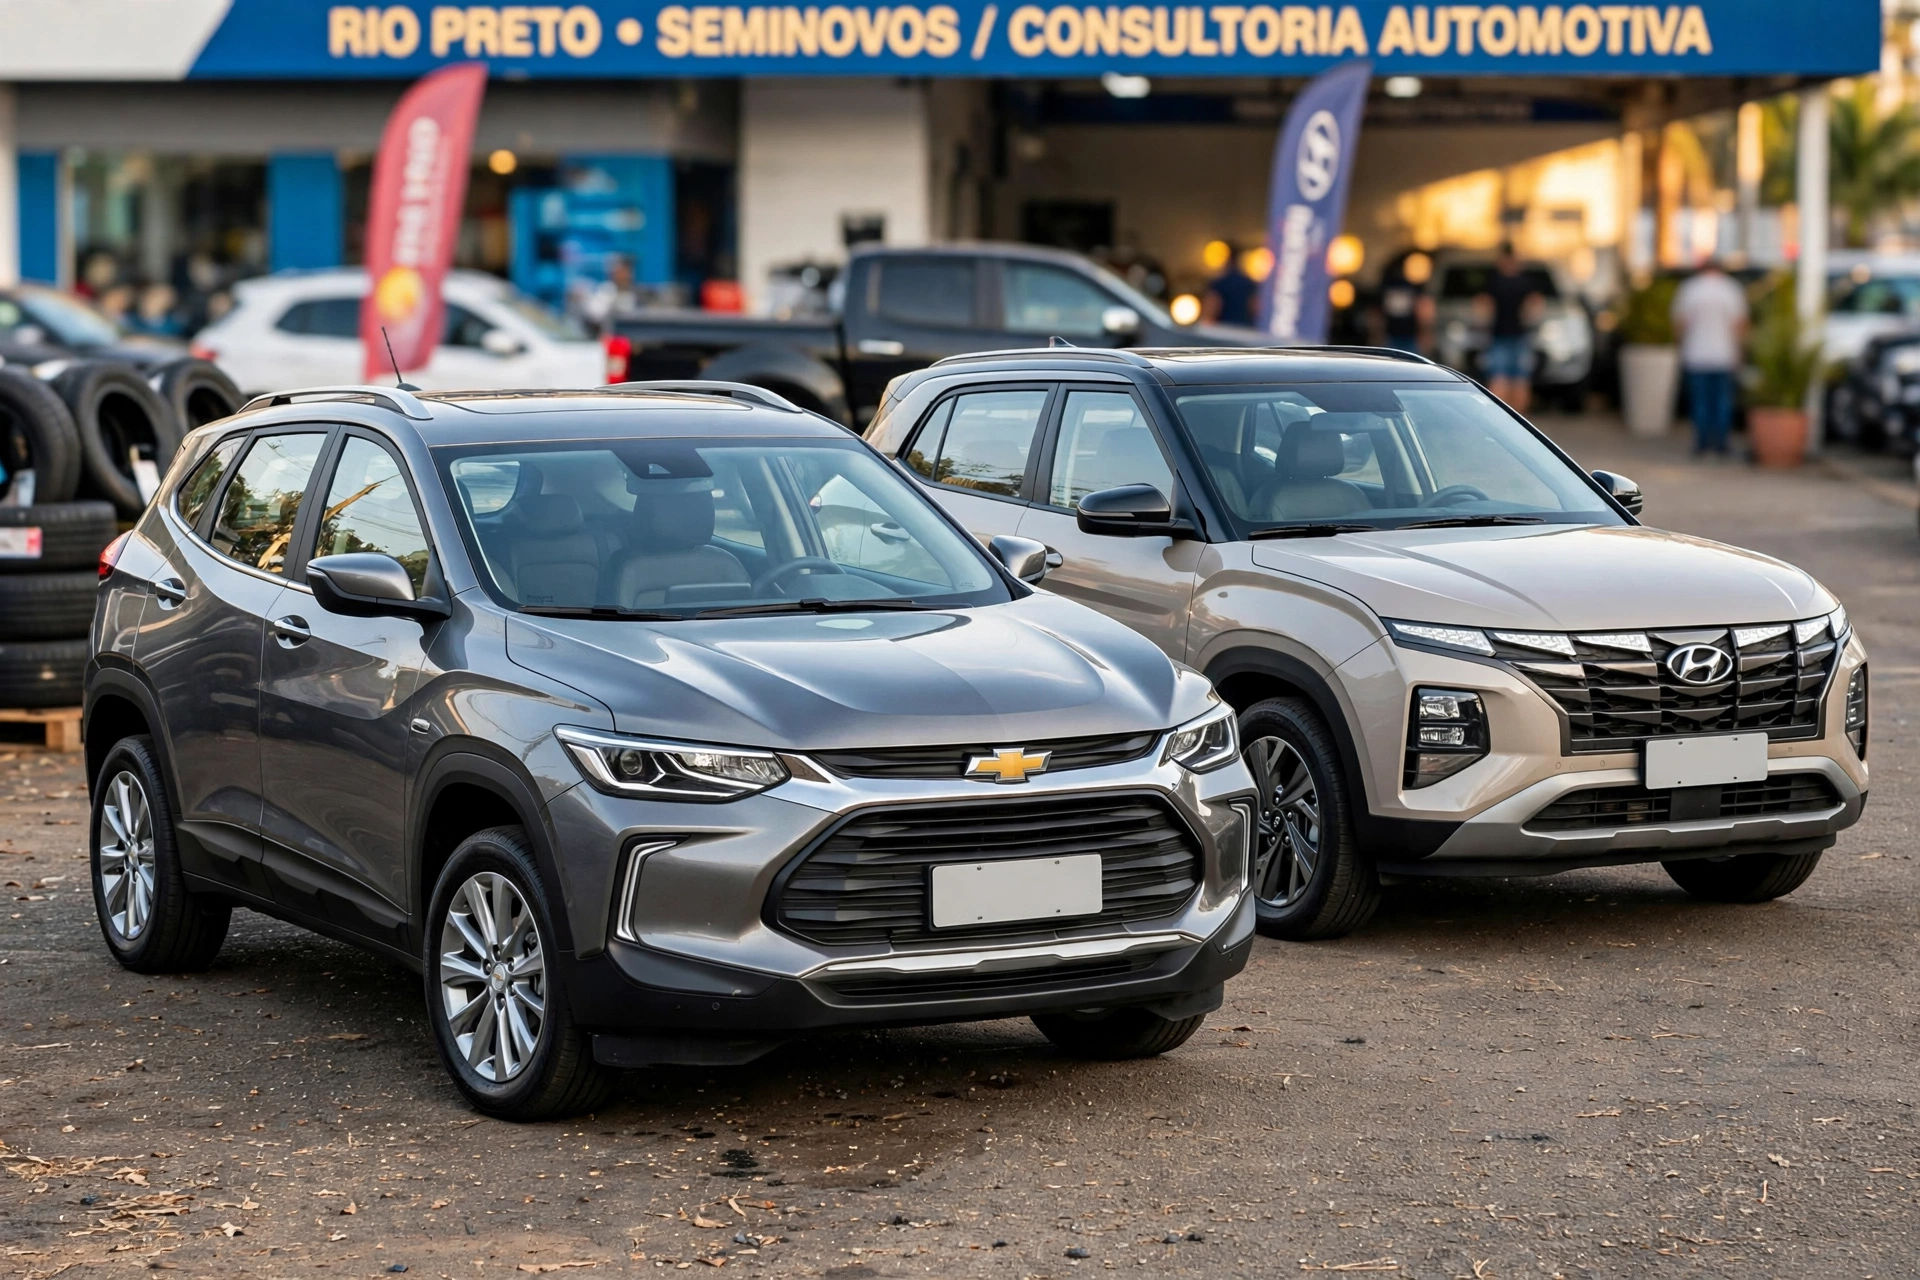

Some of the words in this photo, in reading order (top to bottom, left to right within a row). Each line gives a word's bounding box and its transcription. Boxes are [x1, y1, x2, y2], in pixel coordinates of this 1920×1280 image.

[328, 5, 421, 57] RIO
[430, 5, 602, 57] PRETO
[656, 5, 961, 58] SEMINOVOS
[1007, 5, 1369, 57] CONSULTORIA
[1377, 4, 1713, 56] AUTOMOTIVA
